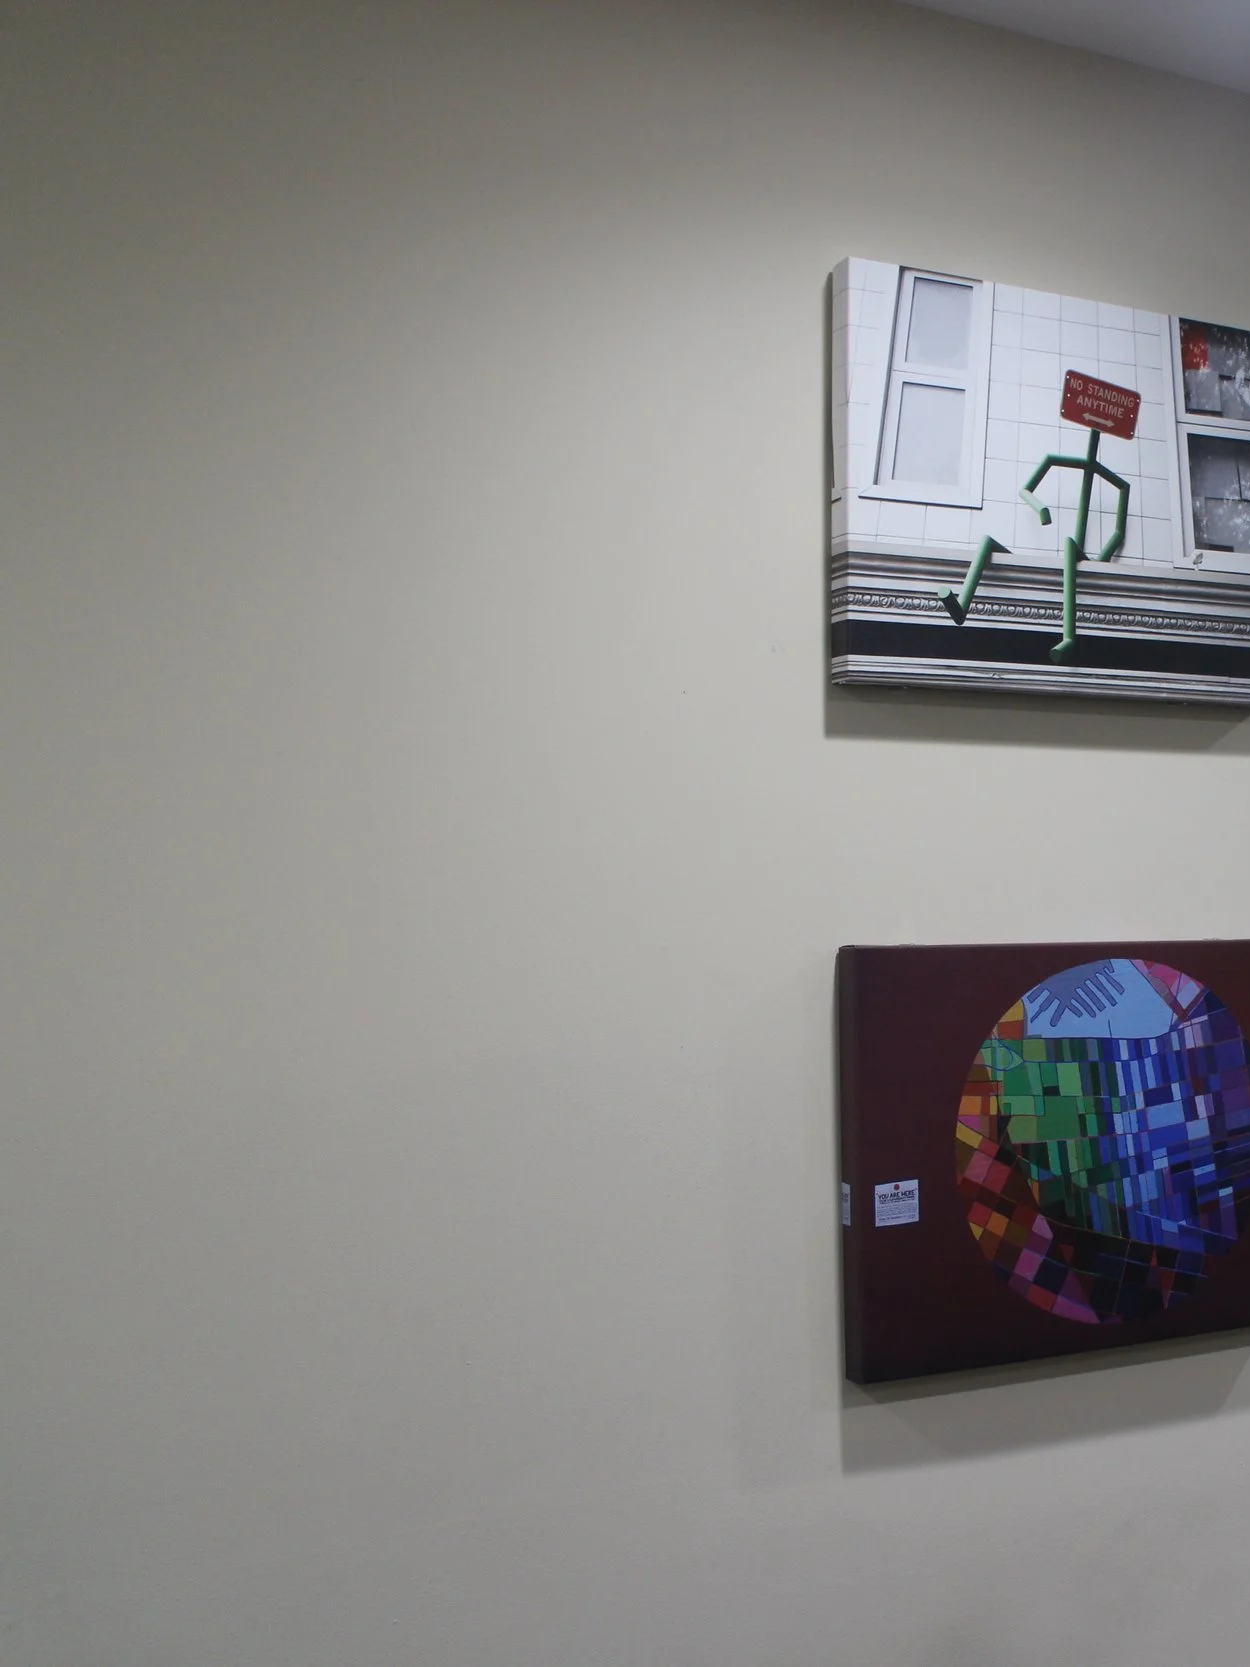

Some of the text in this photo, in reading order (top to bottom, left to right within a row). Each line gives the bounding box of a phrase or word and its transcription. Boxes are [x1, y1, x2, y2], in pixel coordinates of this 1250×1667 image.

[1070, 378, 1135, 408] NO STANDING
[1076, 395, 1125, 419] ANYTIME
